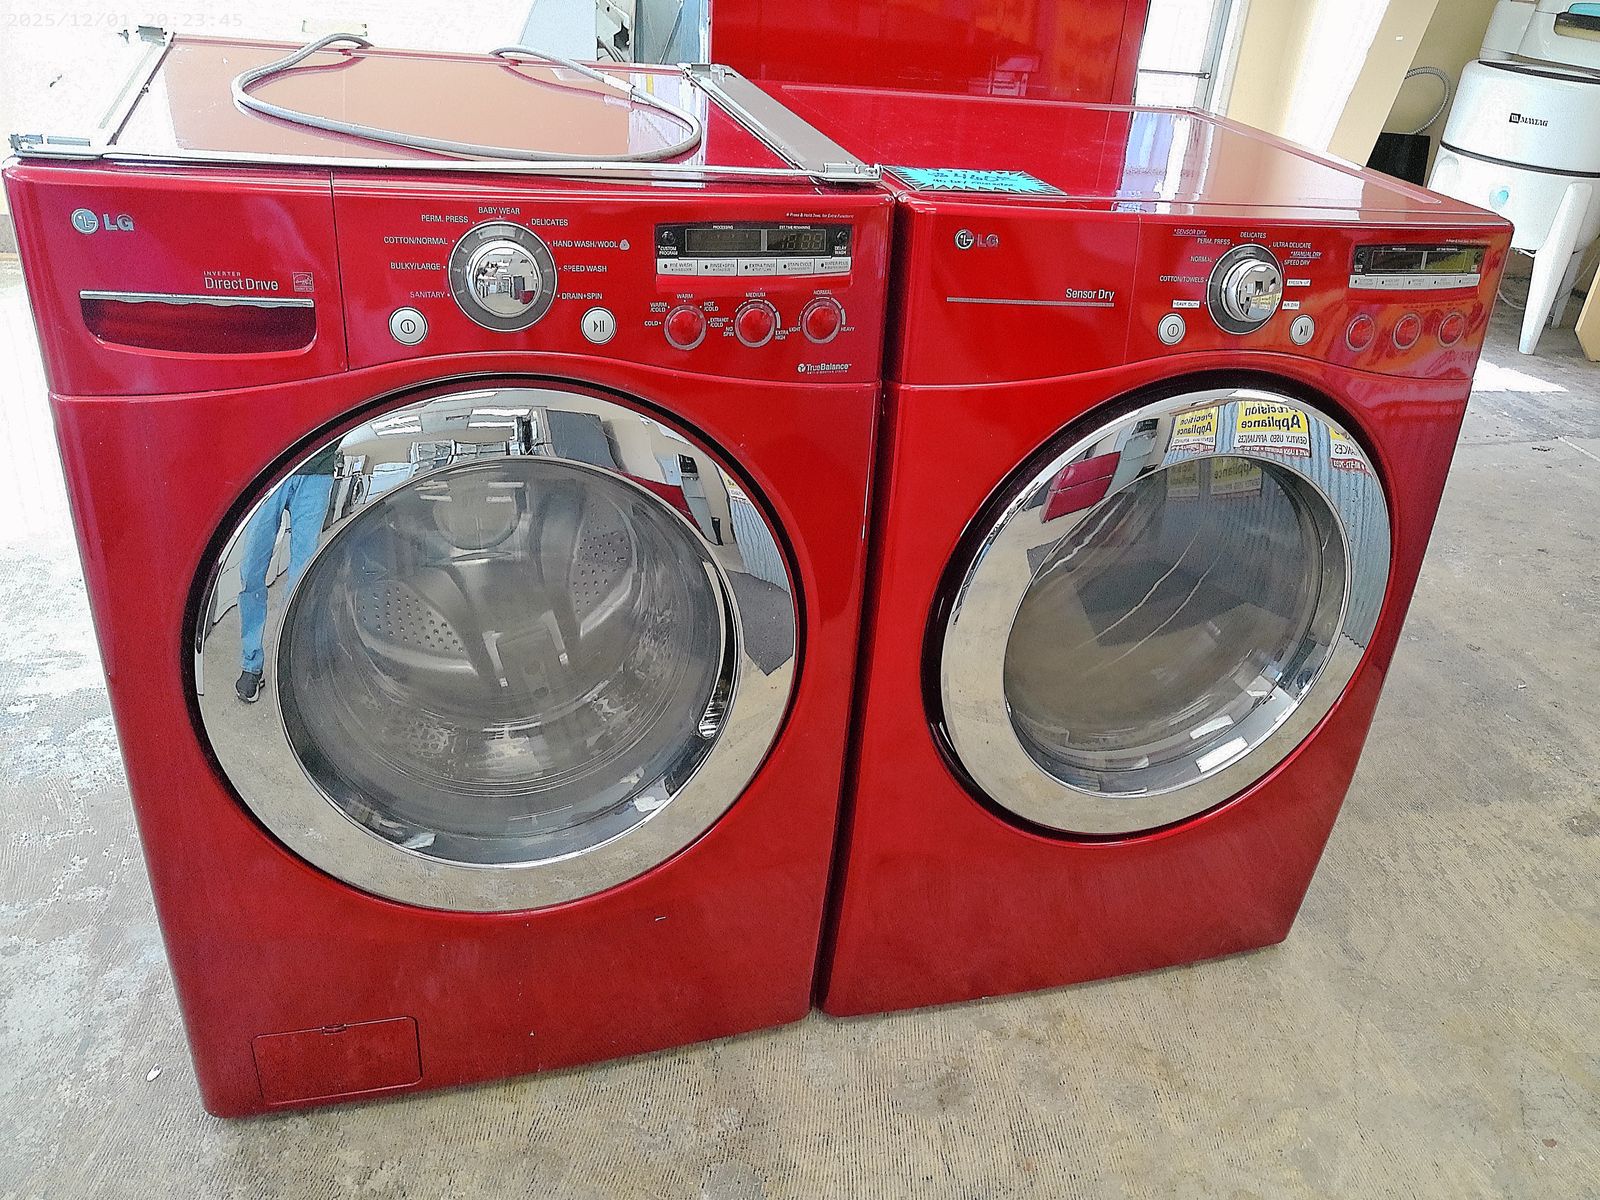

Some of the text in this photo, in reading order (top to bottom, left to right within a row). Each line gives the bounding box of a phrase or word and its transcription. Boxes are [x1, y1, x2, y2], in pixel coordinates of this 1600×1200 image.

[478, 207, 520, 215] BABY WEAR
[103, 213, 135, 232] LG
[421, 214, 469, 223] PERM. PRESS
[531, 218, 569, 227] DELICATES
[1240, 231, 1267, 239] DELICATES
[383, 236, 448, 245] COTTON/NORMAL
[552, 239, 618, 249] HAND WASH/WOOL
[976, 233, 999, 248] LG
[1191, 255, 1212, 263] NORMAL
[390, 261, 441, 270] BULKY/LARGE
[585, 265, 608, 273] WASH
[204, 277, 245, 290] Direct
[245, 278, 279, 291] Drive
[410, 291, 445, 299] SANITARY
[1065, 288, 1115, 301] Sensor Dry
